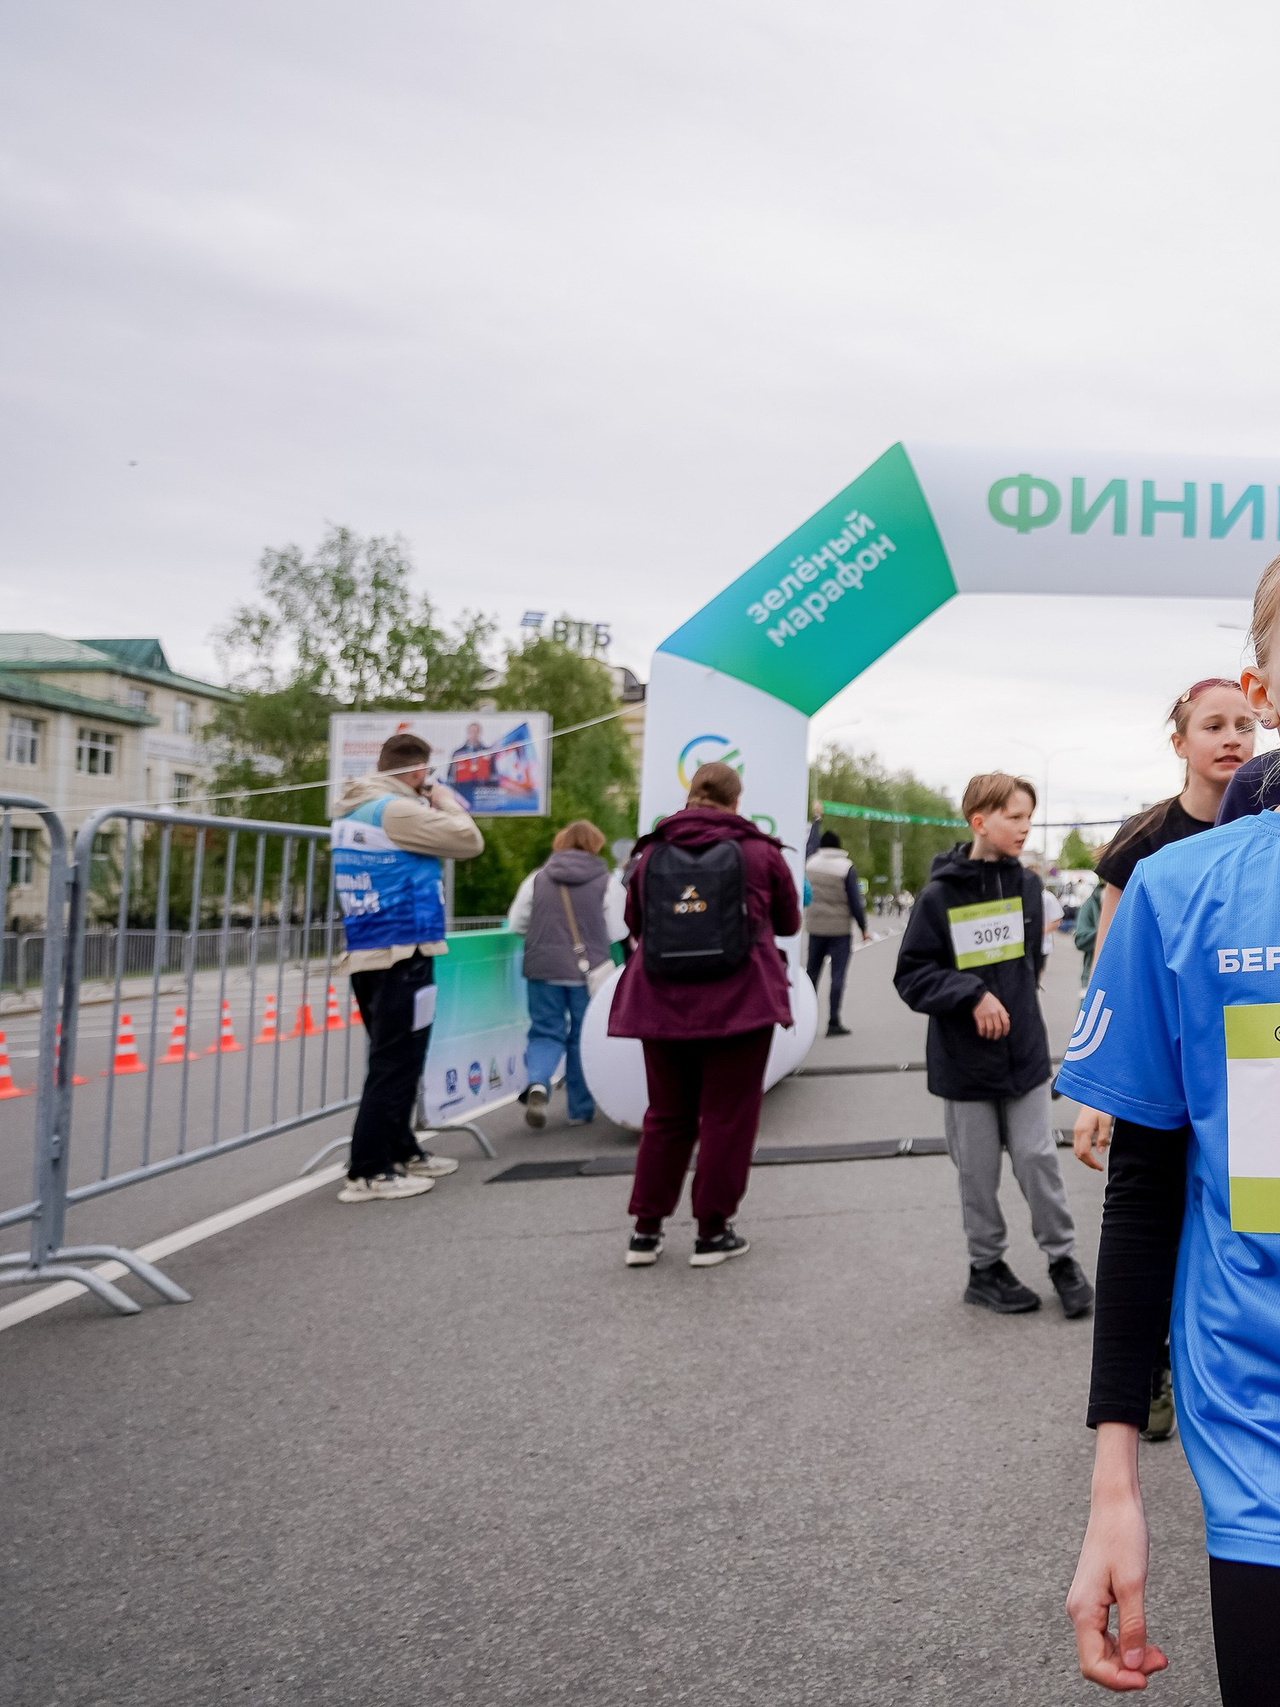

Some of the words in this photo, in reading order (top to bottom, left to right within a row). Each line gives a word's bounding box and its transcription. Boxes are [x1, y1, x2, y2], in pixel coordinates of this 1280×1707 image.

[746, 509, 876, 625] зелёный
[766, 533, 897, 648] марафон
[553, 619, 612, 647] ВТБ
[973, 925, 1010, 945] 3092
